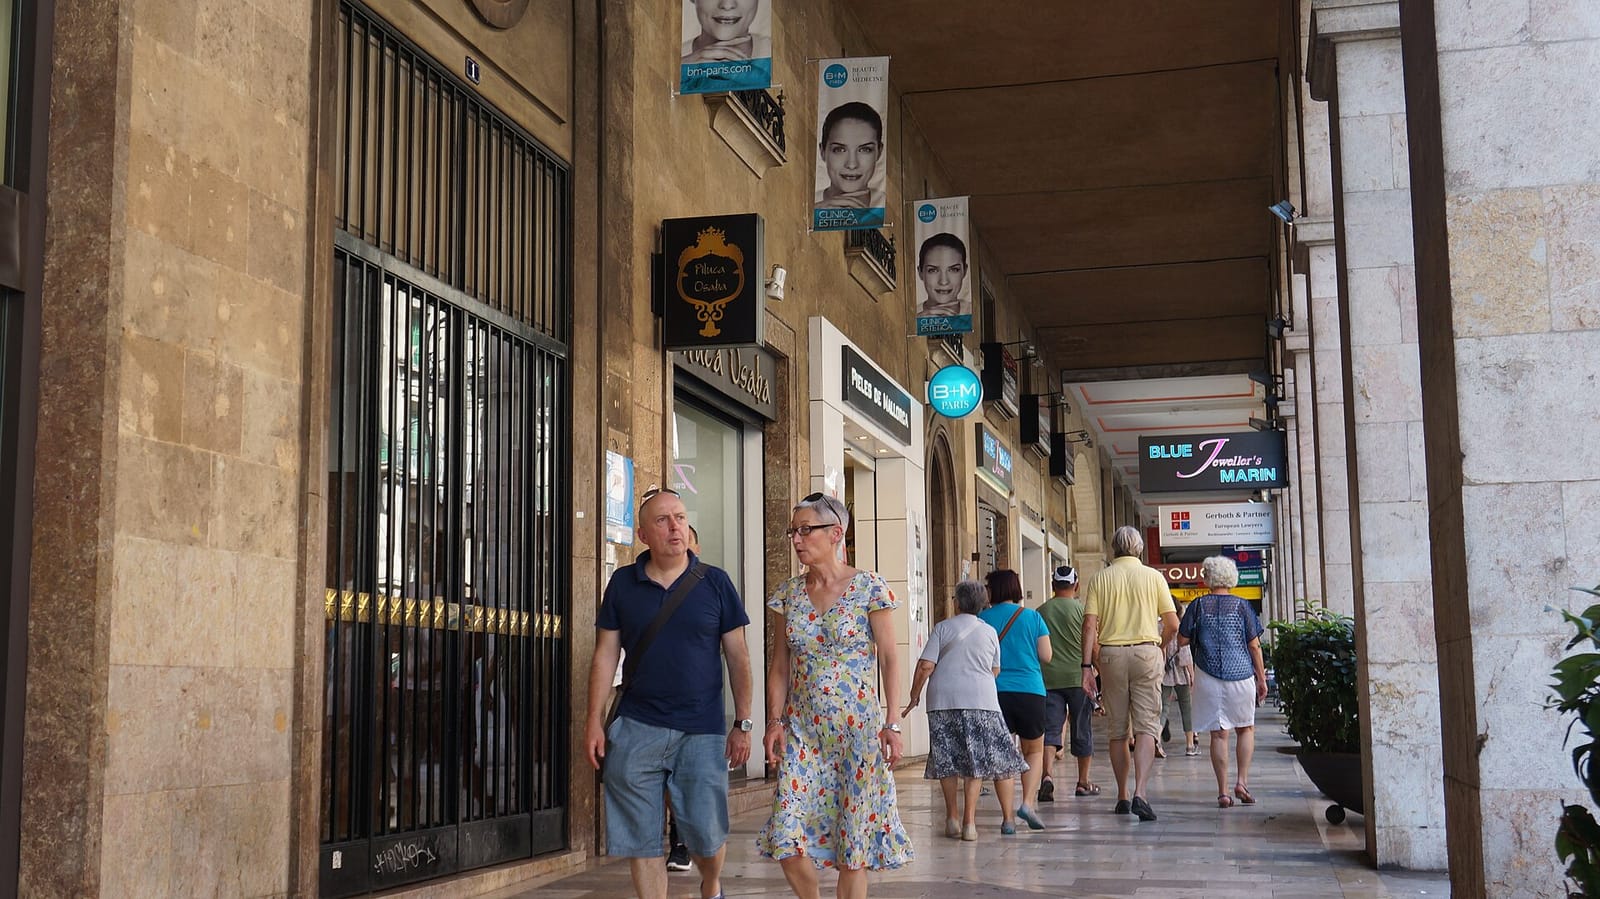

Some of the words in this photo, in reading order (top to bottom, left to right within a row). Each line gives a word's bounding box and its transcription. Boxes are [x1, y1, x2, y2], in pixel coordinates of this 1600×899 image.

[687, 64, 752, 78] bm-paris.com
[851, 366, 873, 400] PIELES
[873, 387, 882, 407] DE
[882, 392, 909, 429] MALLORCA
[933, 383, 977, 399] B+M
[941, 400, 970, 410] PARIS
[1148, 443, 1193, 459] BLUE
[1220, 467, 1277, 483] MARIN
